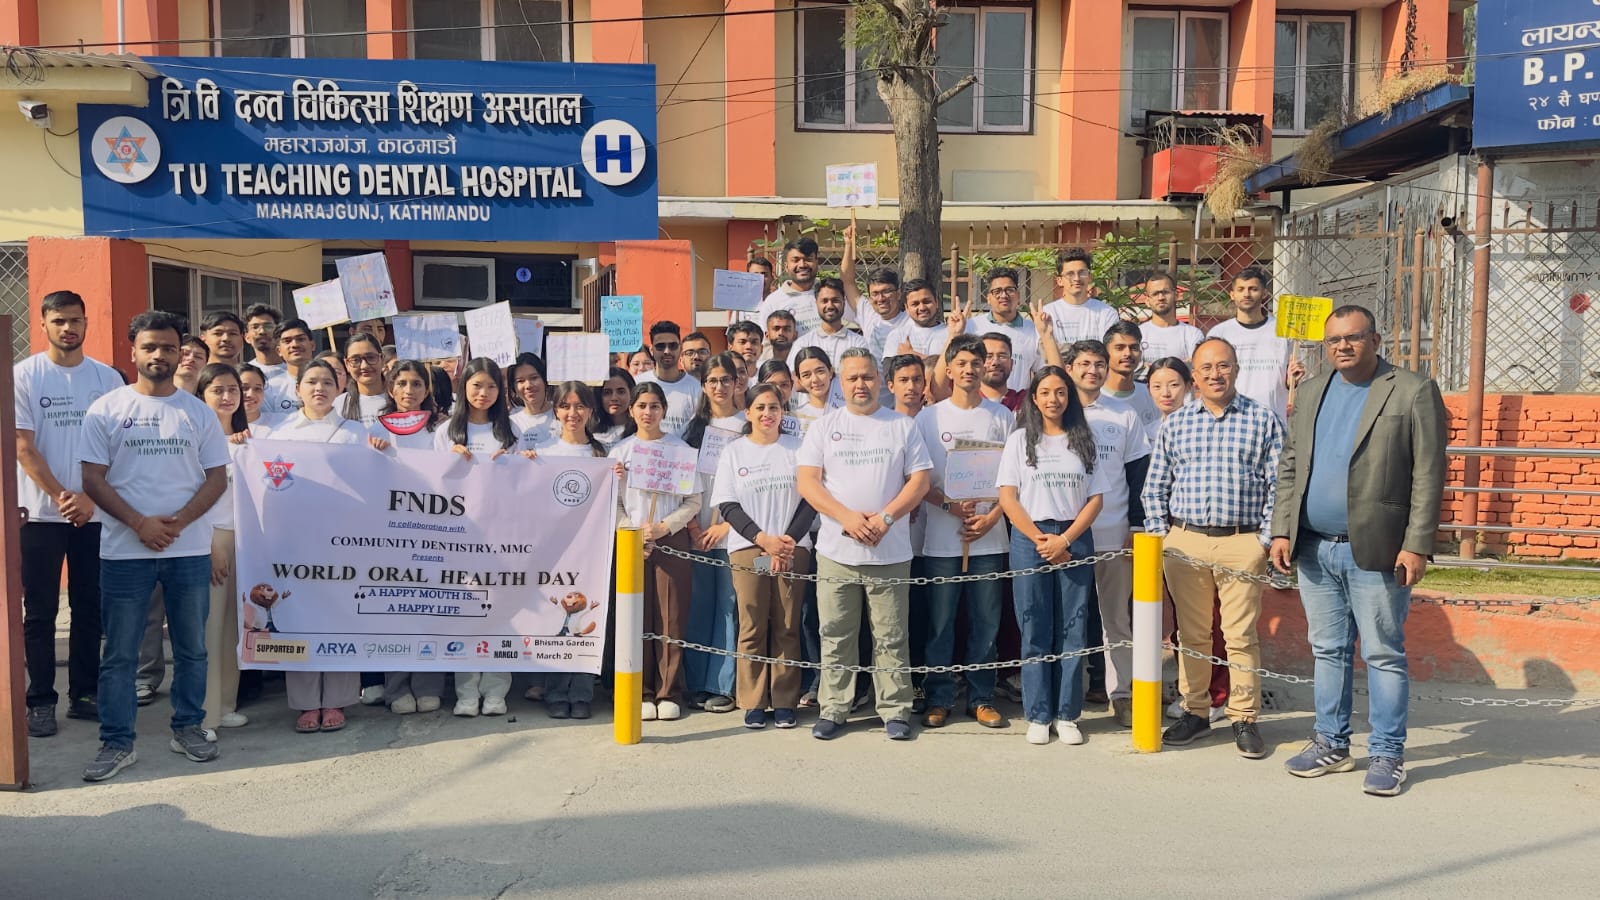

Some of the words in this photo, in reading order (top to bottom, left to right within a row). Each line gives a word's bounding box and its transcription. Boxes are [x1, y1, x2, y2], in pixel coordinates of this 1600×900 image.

[195, 78, 221, 121] वि
[234, 89, 285, 122] दन्त
[292, 79, 391, 125] चिकित्सा
[397, 80, 474, 127] शिक्षण
[482, 92, 583, 126] अस्पताल
[1528, 96, 1550, 111] २४
[1537, 114, 1576, 130] फोन
[595, 134, 633, 174] H
[221, 163, 351, 196] TEACHING
[359, 164, 456, 196] DENTAL
[461, 165, 583, 198] HOSPITAL
[256, 203, 384, 223] MAHARAJGUNJ,
[389, 204, 491, 222] KATHMANDU
[387, 489, 466, 517] FNDS
[397, 520, 447, 533] collaboration
[449, 524, 465, 533] with
[331, 535, 418, 550] COMMUNITY
[421, 540, 497, 555] DENTISTRY,
[500, 543, 533, 555] MMC
[411, 553, 444, 563] Presents
[272, 563, 356, 581] WORLD
[368, 566, 429, 583] ORAL
[440, 569, 527, 586] HEALTH
[538, 571, 580, 586] DAY
[379, 588, 417, 598] HAPPY
[419, 590, 460, 600] MOUTH
[387, 603, 396, 612] A
[398, 603, 435, 614] HAPPY
[437, 605, 461, 615] LIFE
[256, 644, 295, 654] SUPPORTED
[296, 645, 306, 655] BY
[316, 642, 357, 655] ARYA
[377, 643, 411, 654] MSDH
[501, 639, 512, 648] SAI
[534, 639, 564, 648] Bhisma
[565, 640, 595, 648] Garden
[493, 650, 519, 659] NANGLO
[536, 652, 562, 660] March
[563, 652, 573, 660] 20
